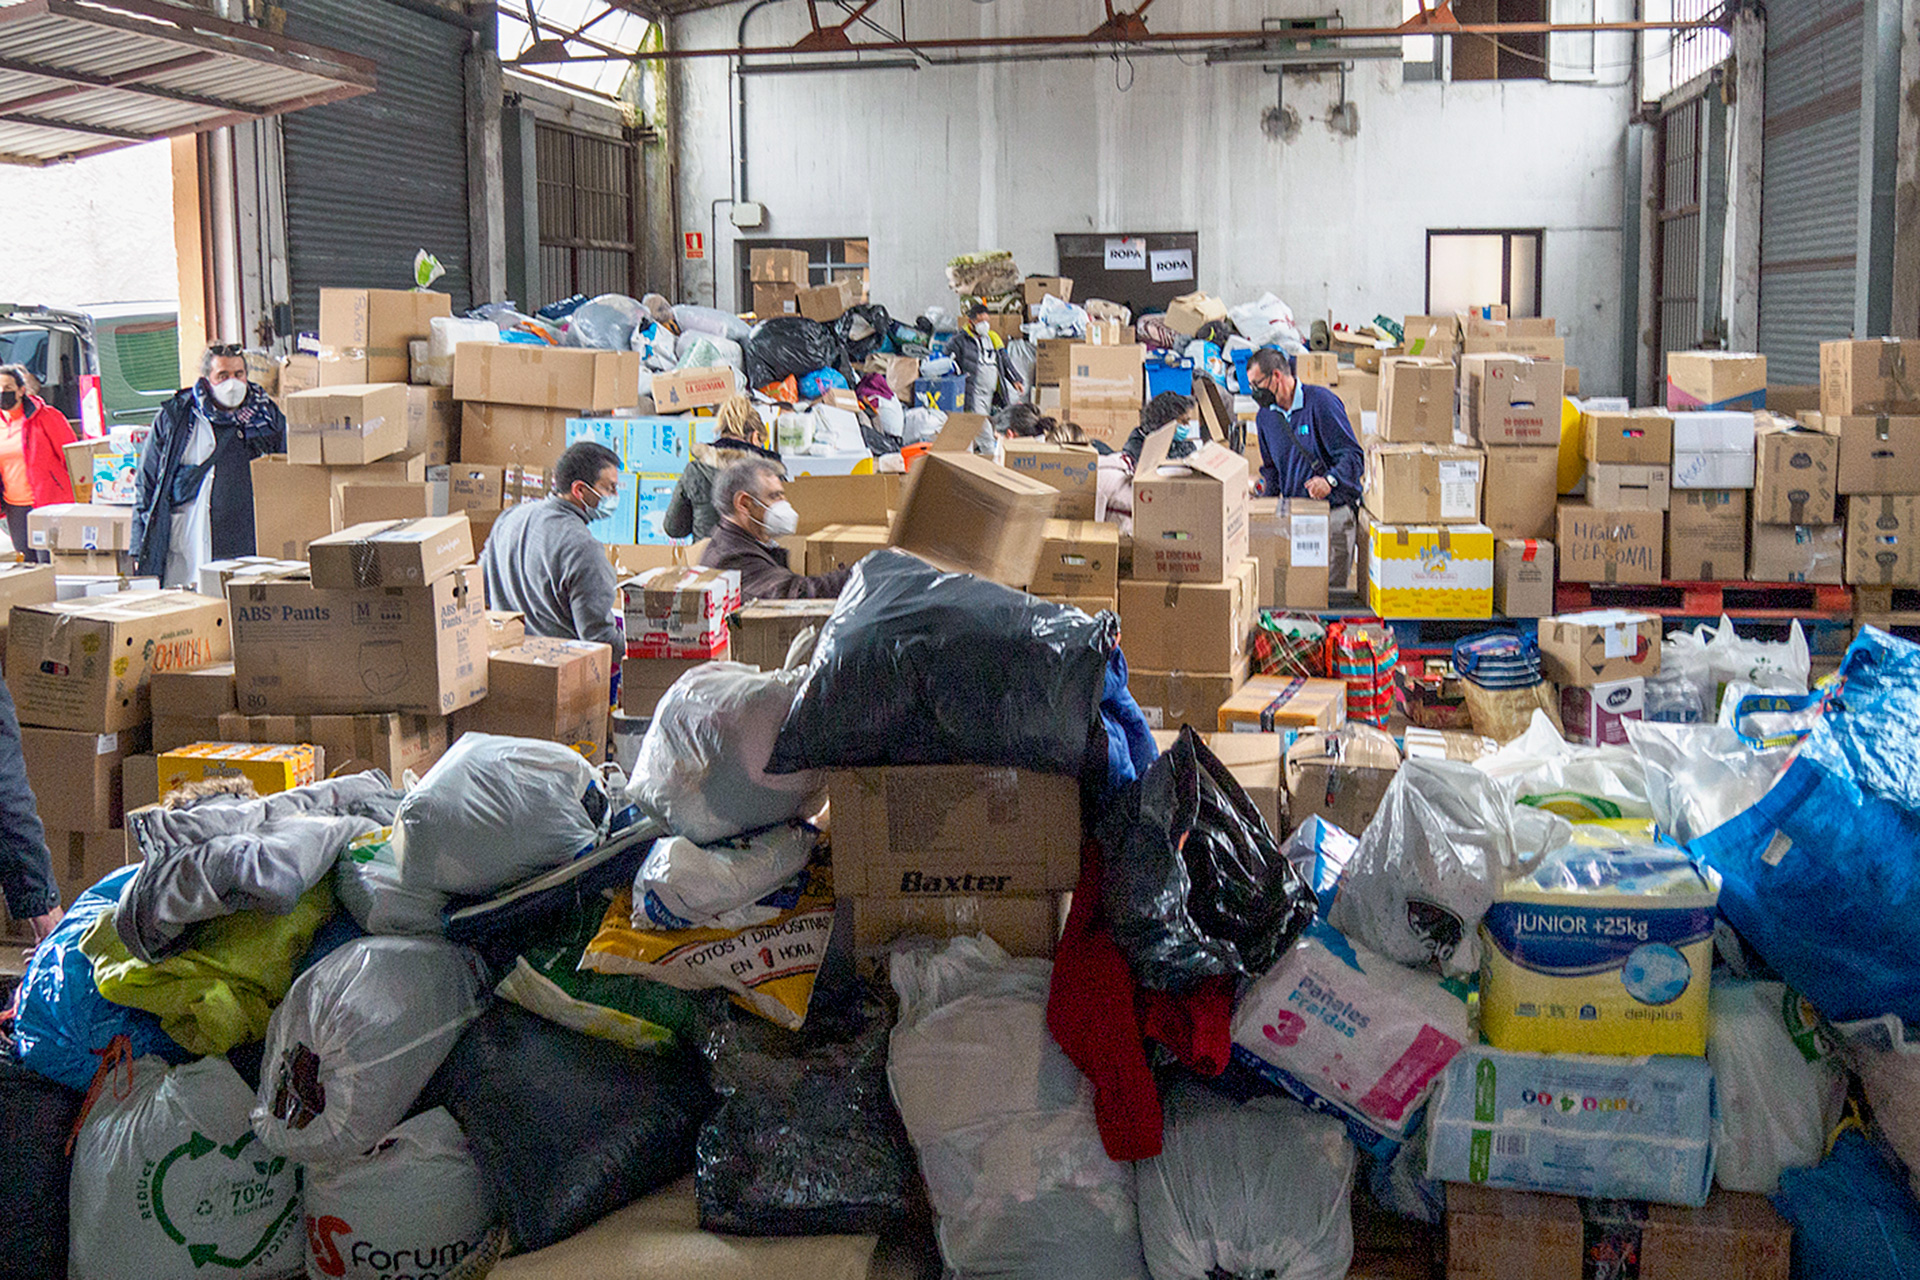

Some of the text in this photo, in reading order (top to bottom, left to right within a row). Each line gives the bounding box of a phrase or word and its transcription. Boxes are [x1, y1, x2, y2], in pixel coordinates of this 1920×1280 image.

[1110, 249, 1142, 259] ROPA
[1156, 260, 1189, 271] ROPA
[1492, 367, 1504, 379] G
[662, 425, 674, 454] BABY
[1139, 489, 1153, 504] G
[1164, 550, 1202, 561] DOCENAS
[1572, 543, 1653, 571] PERSONAL
[1157, 562, 1200, 573] DE HUEVOS
[281, 605, 330, 621] Pants
[357, 603, 370, 617] M
[248, 694, 267, 707] 80
[442, 691, 455, 707] 80
[901, 870, 1012, 893] Baxter
[1515, 912, 1588, 934] JUNIOR
[1593, 916, 1649, 941] +25kg
[685, 915, 831, 968] FOTOS Y DIAPOSITIVAS
[730, 943, 815, 976] EN 1 HORA
[1298, 975, 1371, 1029] Pañales
[1288, 989, 1357, 1039] Fraldas
[1624, 1006, 1683, 1024] deliplus
[1262, 1009, 1307, 1047] 3
[137, 1159, 156, 1220] REDUCE
[230, 1181, 274, 1207] 70%
